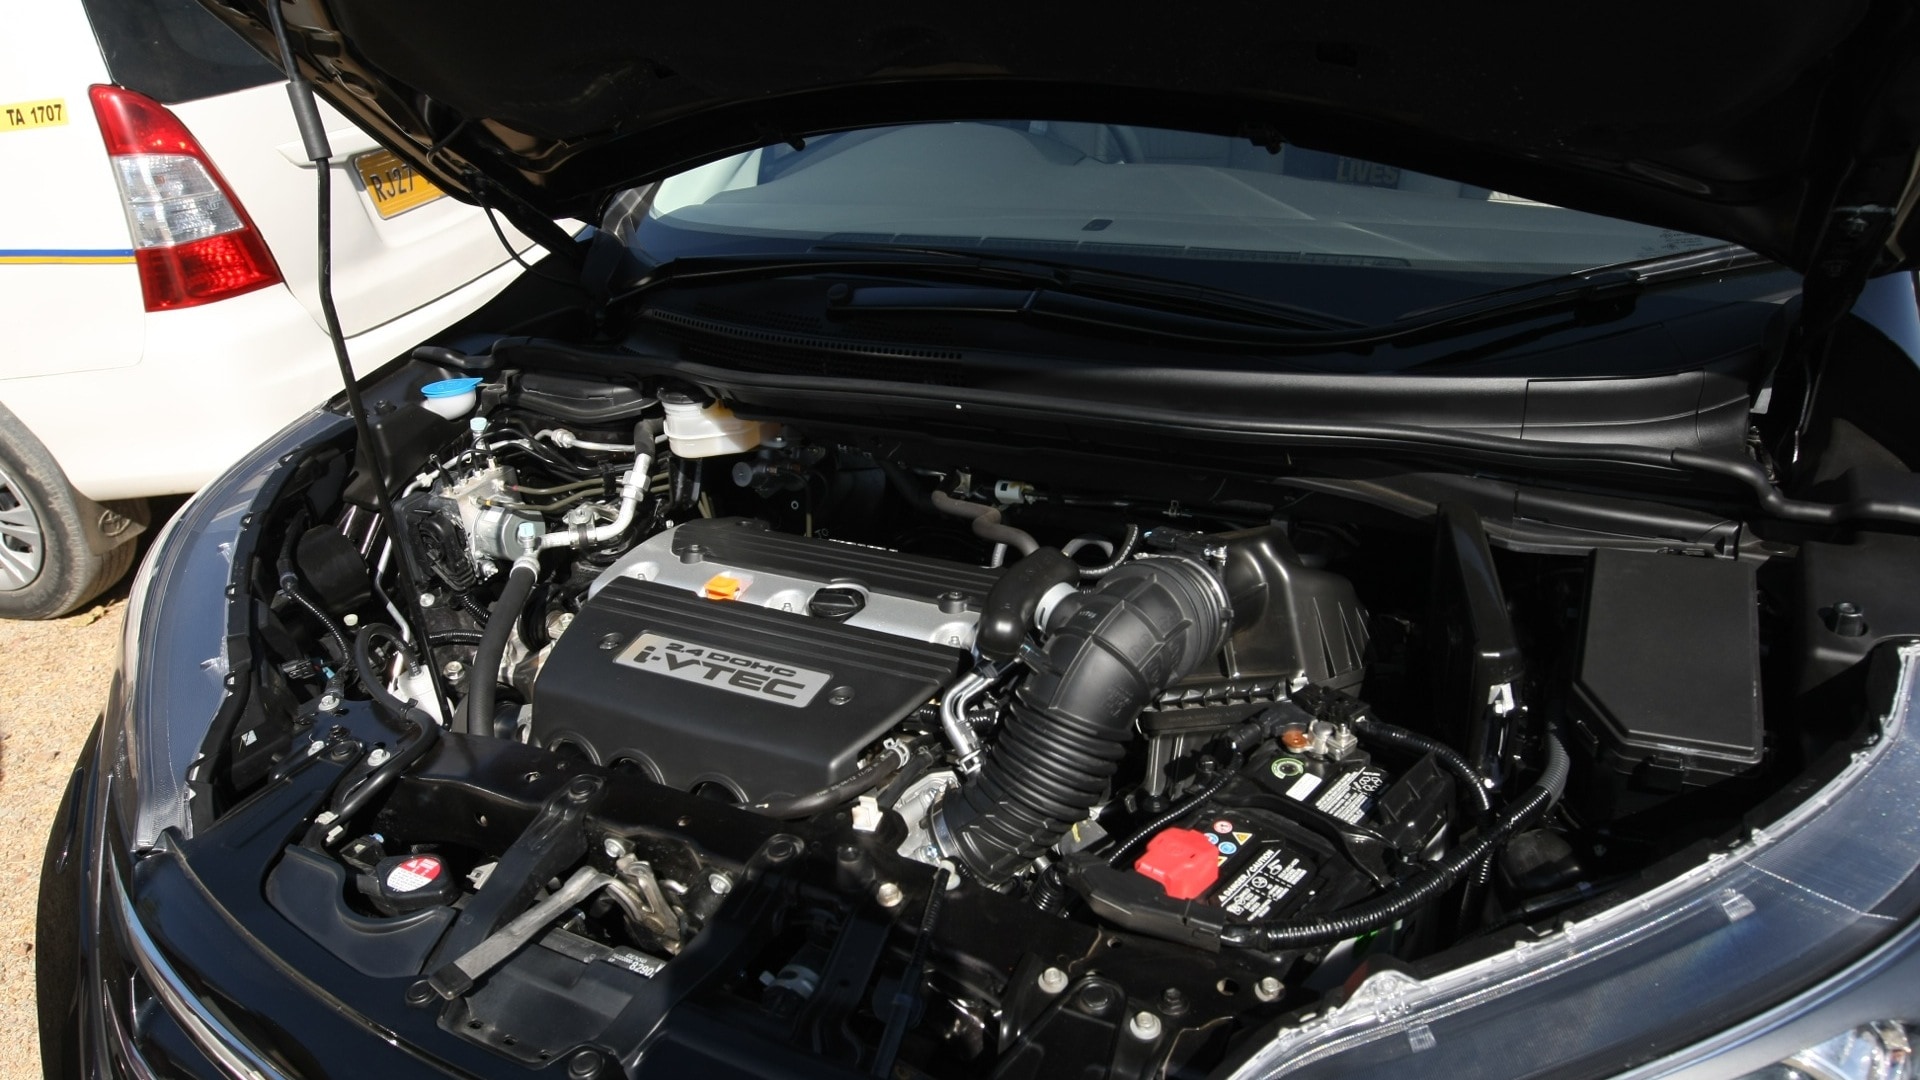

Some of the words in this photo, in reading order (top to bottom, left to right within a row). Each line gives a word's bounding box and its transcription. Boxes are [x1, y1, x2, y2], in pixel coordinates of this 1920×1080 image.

[6, 108, 26, 126] TA
[30, 103, 62, 124] 1707
[369, 163, 414, 203] RJ27
[633, 645, 806, 700] i-VTEC
[665, 642, 704, 657] 2.4
[707, 652, 797, 677] DOHC
[629, 961, 655, 977] 8290
